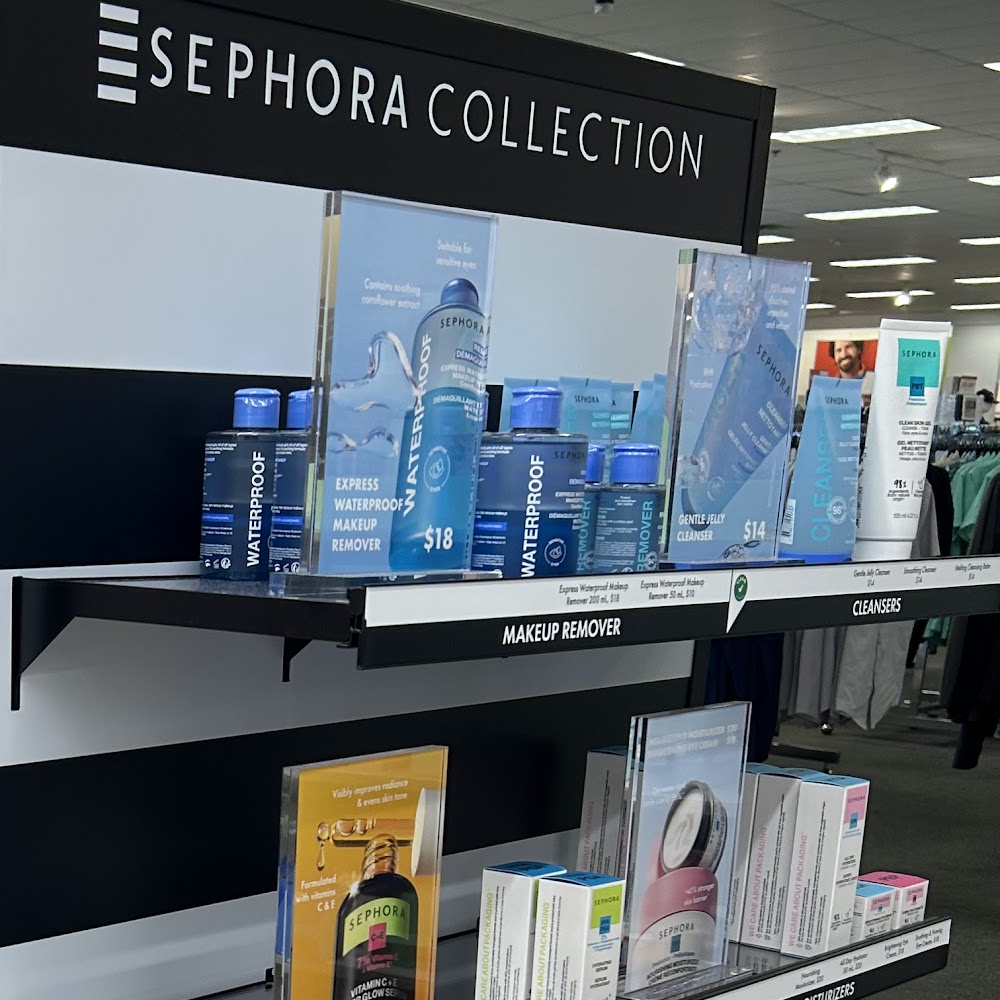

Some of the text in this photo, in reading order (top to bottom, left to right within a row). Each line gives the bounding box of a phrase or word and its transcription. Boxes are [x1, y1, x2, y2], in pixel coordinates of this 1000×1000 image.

[150, 26, 704, 180] SEPHORA COLLECTION
[364, 278, 392, 291] Contains
[440, 317, 485, 335] SEPHORA
[901, 350, 937, 358] SEPHORA
[756, 344, 792, 396] SEPHORA
[403, 334, 432, 518] WATERPROOF
[335, 477, 379, 492] EXPRESS
[247, 451, 266, 567] WATERPROOF
[334, 497, 404, 512] WATERPROOF
[333, 518, 378, 532] MAKEUP
[521, 454, 545, 578] WATERPROOF
[678, 513, 726, 526] GENTLE JELLY
[676, 529, 713, 543] CLEANSER
[743, 519, 766, 542] $14
[332, 538, 381, 552] REMOVER
[423, 527, 454, 554] $18
[559, 582, 629, 594] Express Waterproof Makeup
[640, 578, 705, 590] Express Waterproof Makeup
[566, 596, 588, 605] Remover
[648, 591, 668, 600] Remover
[852, 597, 902, 617] CLEANSERS
[502, 617, 621, 645] MAKEUP REMOVER
[332, 778, 409, 799] Visibly improves radiance
[356, 792, 408, 807] & evens skin tone
[756, 823, 767, 870] PACKAGING
[793, 831, 807, 909] ABOUT PACKAGING
[301, 875, 337, 889] Formulated
[310, 888, 336, 901] vitamins
[317, 899, 336, 911] C & E
[349, 903, 407, 931] SEPHORA
[484, 892, 494, 945] PACKAGING
[541, 902, 550, 956] PACKAGING
[658, 922, 695, 939] SEPHORA
[482, 945, 490, 978] ABOUT
[538, 957, 546, 989] ABOUT
[350, 977, 398, 998] VITAMIN C E
